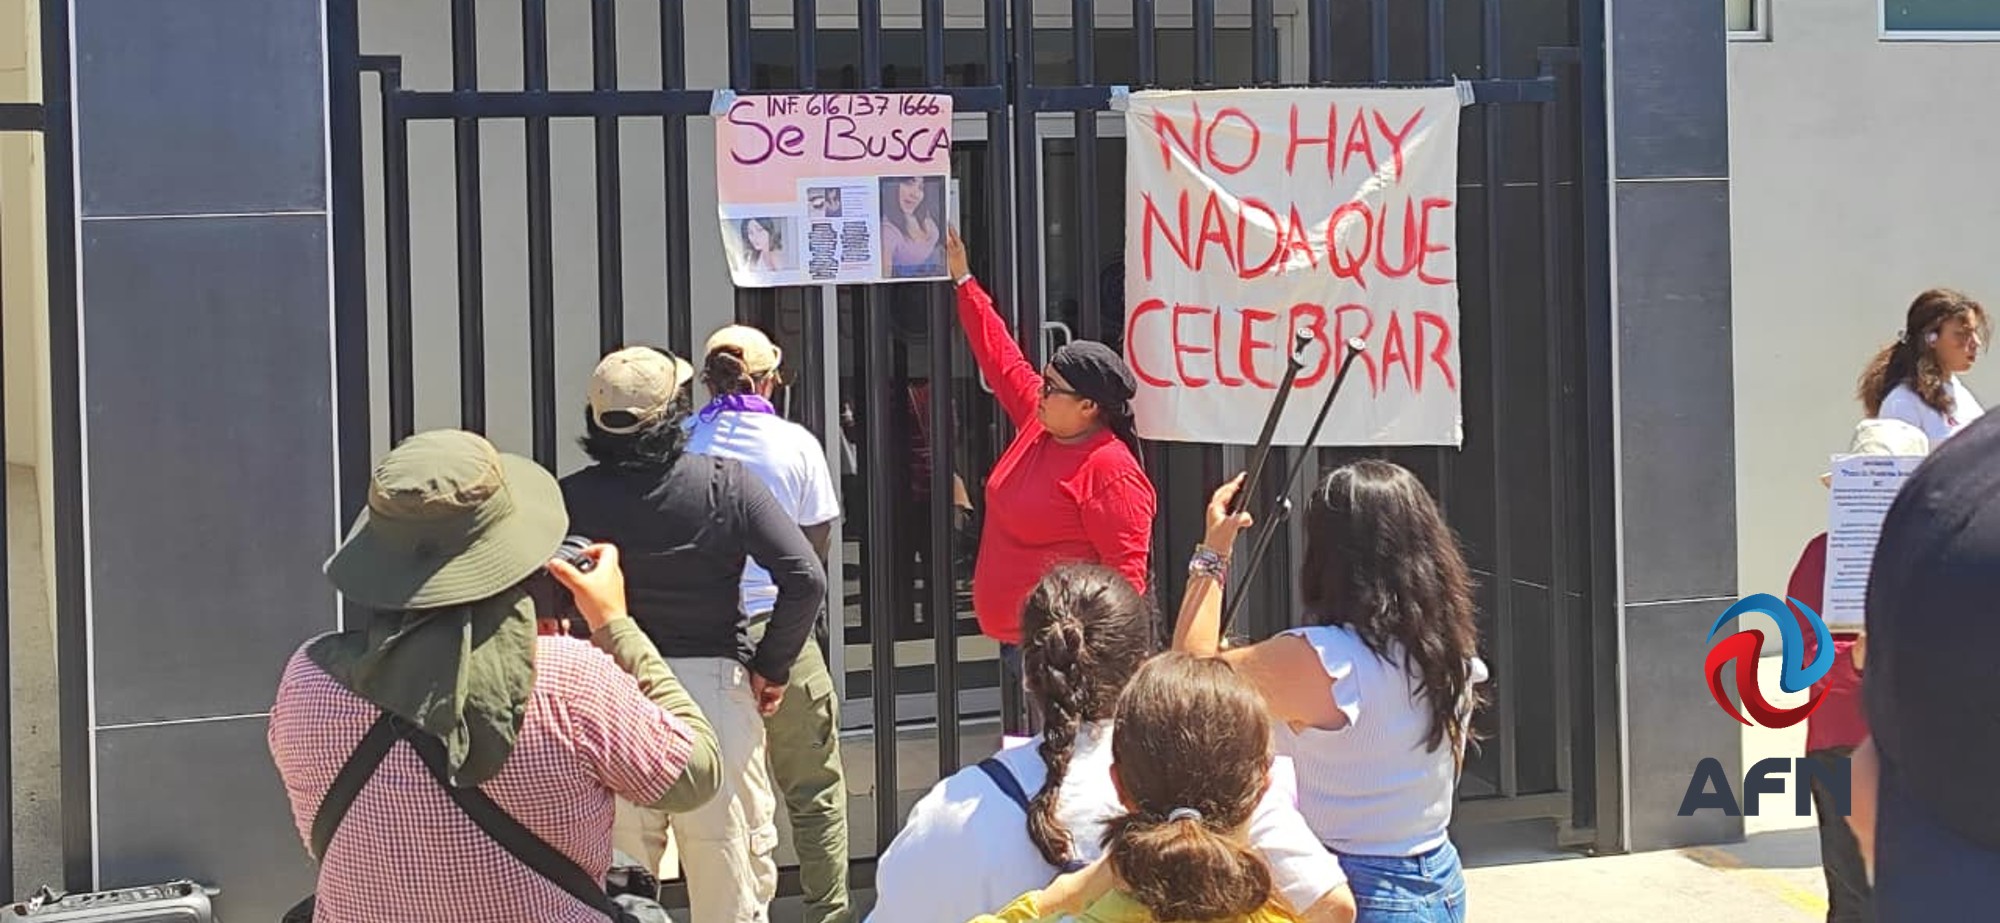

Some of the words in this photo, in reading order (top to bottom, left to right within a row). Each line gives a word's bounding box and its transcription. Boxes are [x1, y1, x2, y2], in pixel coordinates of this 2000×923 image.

[728, 101, 804, 165] Se
[806, 94, 840, 116] 616
[848, 95, 889, 116] 137
[1153, 101, 1260, 175] NO
[1285, 101, 1425, 187] HAY
[1141, 188, 1318, 281] NADA
[1328, 194, 1456, 290] QUE
[1127, 298, 1456, 400] CELEBRAR
